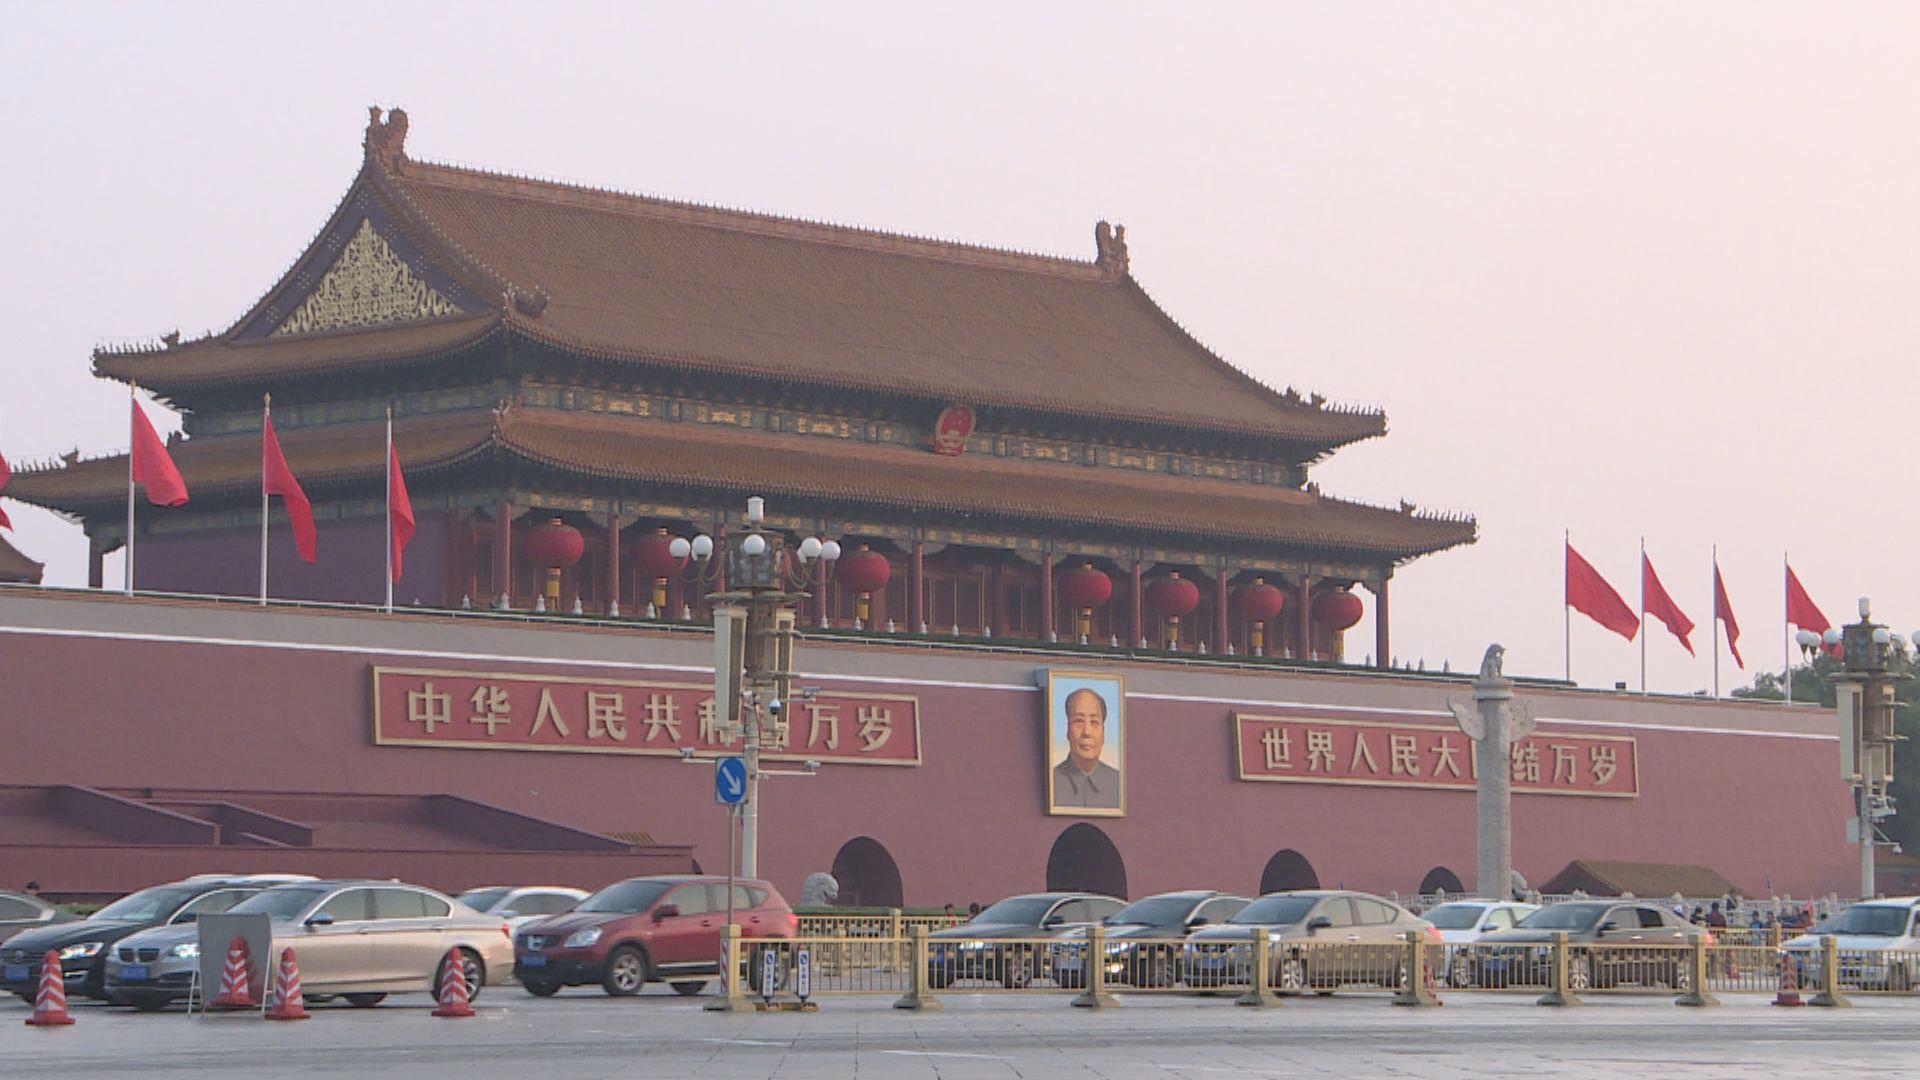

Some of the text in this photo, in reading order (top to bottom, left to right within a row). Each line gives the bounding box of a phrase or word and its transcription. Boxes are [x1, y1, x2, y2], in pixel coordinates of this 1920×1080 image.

[1261, 727, 1617, 785] 世界人民大结万岁
